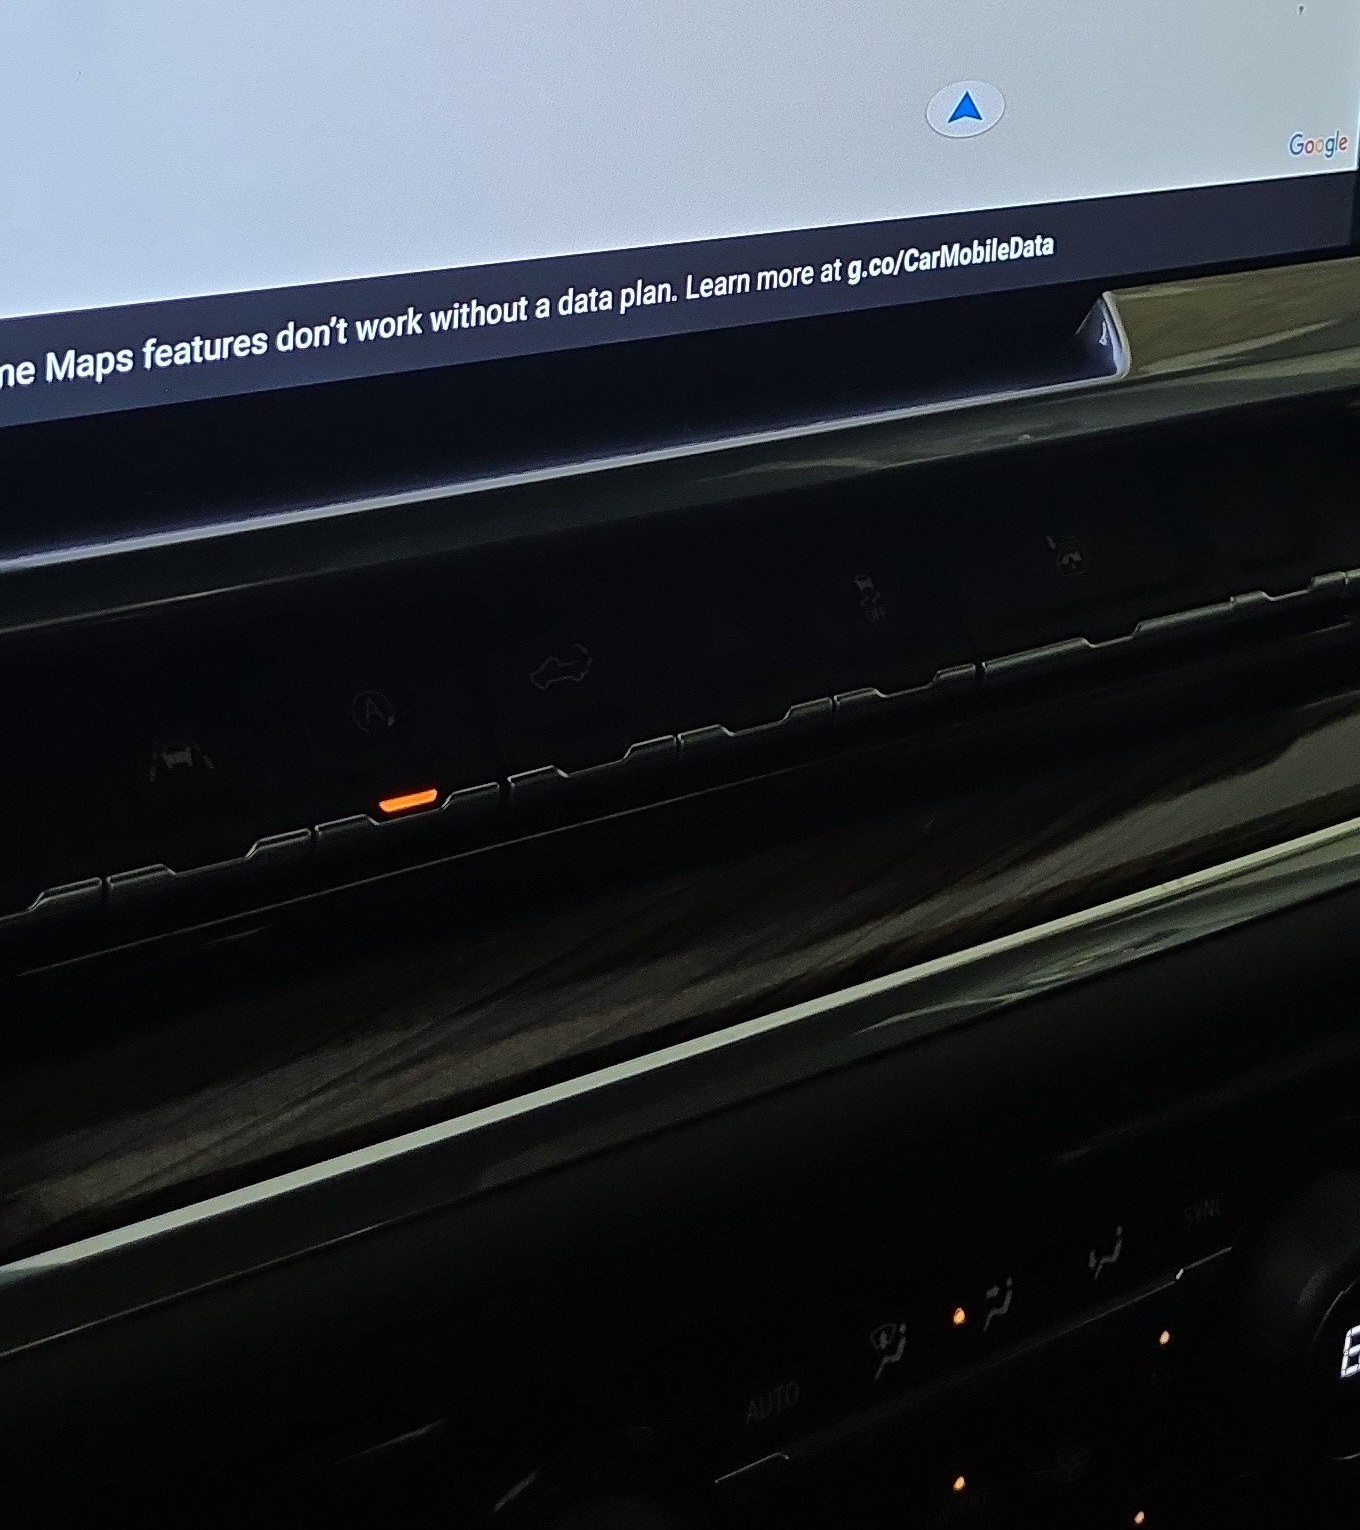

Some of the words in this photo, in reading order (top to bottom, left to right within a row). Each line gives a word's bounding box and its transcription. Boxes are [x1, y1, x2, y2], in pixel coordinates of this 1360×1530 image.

[1289, 129, 1348, 159] Google
[45, 349, 135, 384] Maps
[141, 332, 269, 371] features
[275, 315, 350, 352] don't
[354, 306, 424, 342] work
[429, 296, 530, 334] without
[534, 297, 552, 319] a
[557, 287, 614, 316] data
[619, 278, 679, 315] plan.
[685, 273, 751, 300] Learn
[756, 265, 815, 292] more
[820, 258, 843, 283] at
[847, 234, 1055, 286] g.co/CarMobileData
